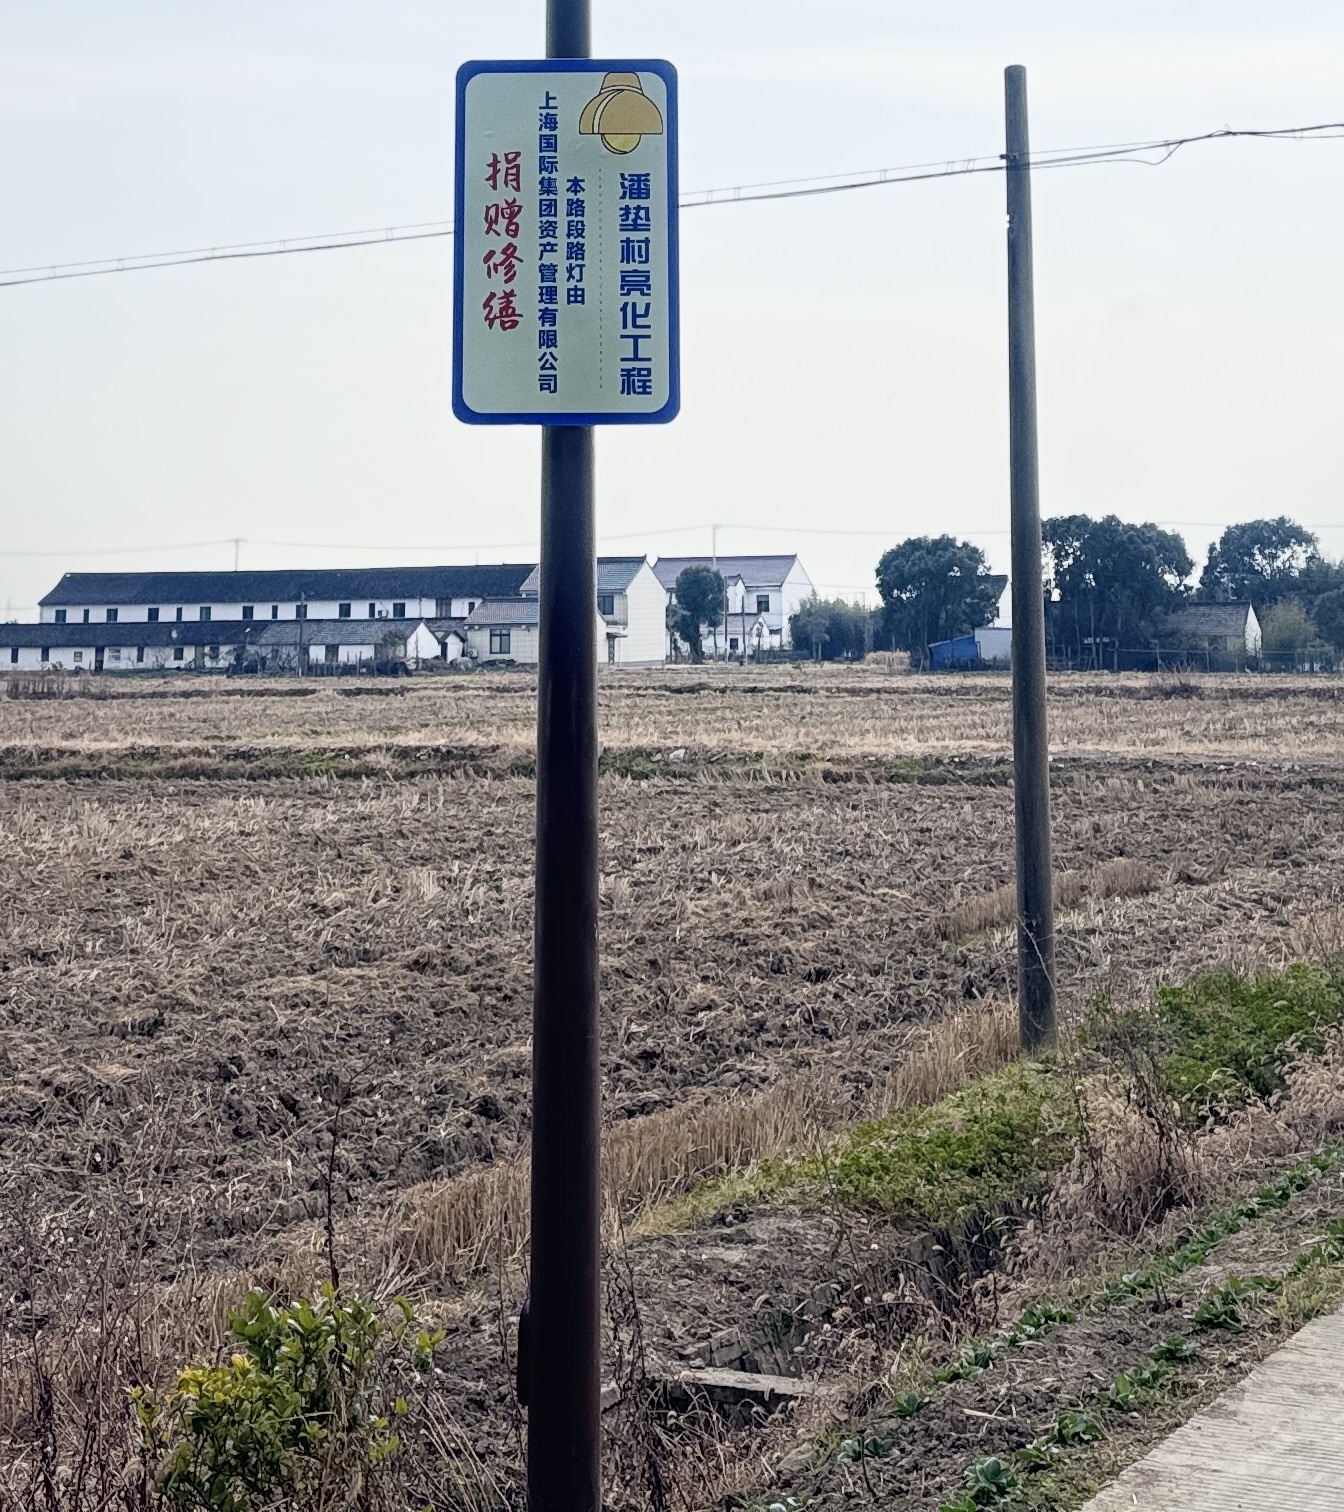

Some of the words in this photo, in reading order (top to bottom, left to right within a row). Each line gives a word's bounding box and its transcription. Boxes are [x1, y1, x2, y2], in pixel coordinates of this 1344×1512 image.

[482, 151, 524, 332] 捐赠修缮
[537, 90, 559, 394] 上海国际集团资产管理有限公司
[565, 176, 586, 306] 本路段路灯由
[618, 172, 653, 396] 潘垫村亮化工程
